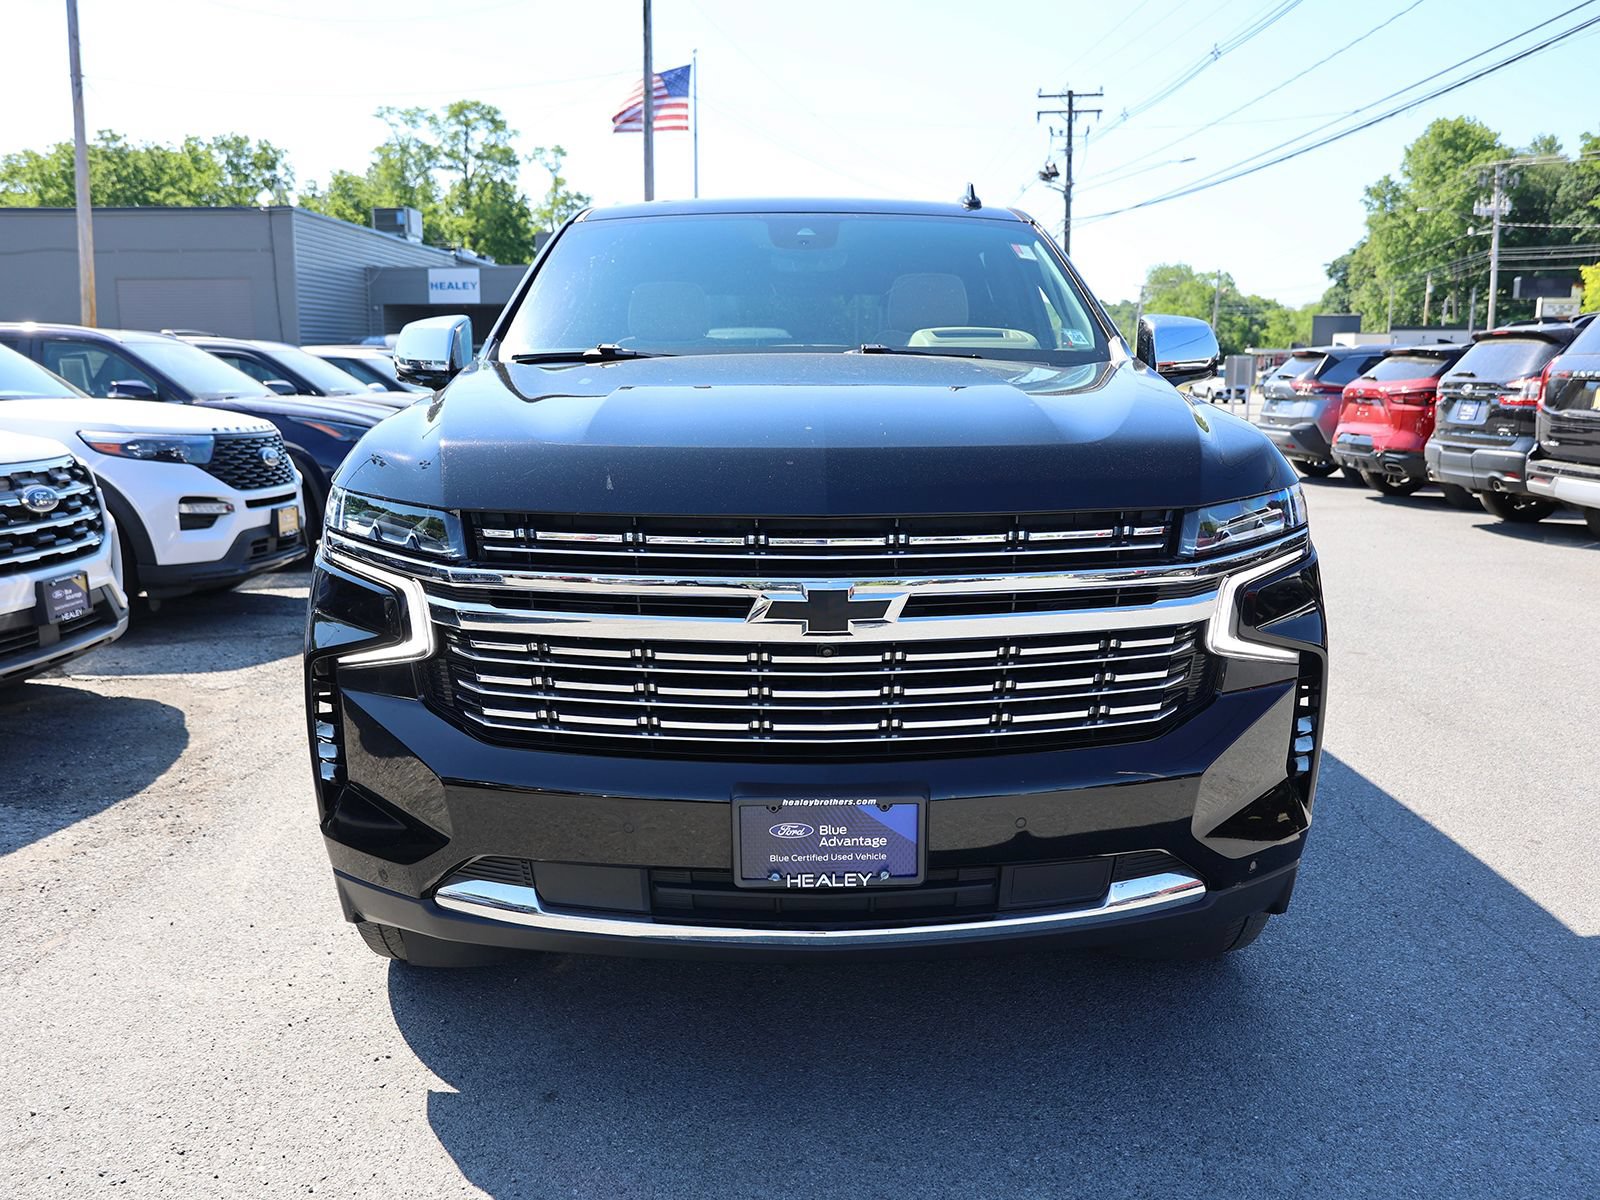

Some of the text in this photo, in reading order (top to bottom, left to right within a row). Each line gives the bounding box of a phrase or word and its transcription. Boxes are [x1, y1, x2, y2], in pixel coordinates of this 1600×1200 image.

[430, 281, 478, 290] HEALEY
[782, 798, 877, 807] healeybrothers.com
[819, 824, 848, 835] Blue
[819, 836, 888, 848] Advantage
[769, 852, 887, 862] Blue Certified Used Vehicle
[786, 872, 873, 888] HEALEY
